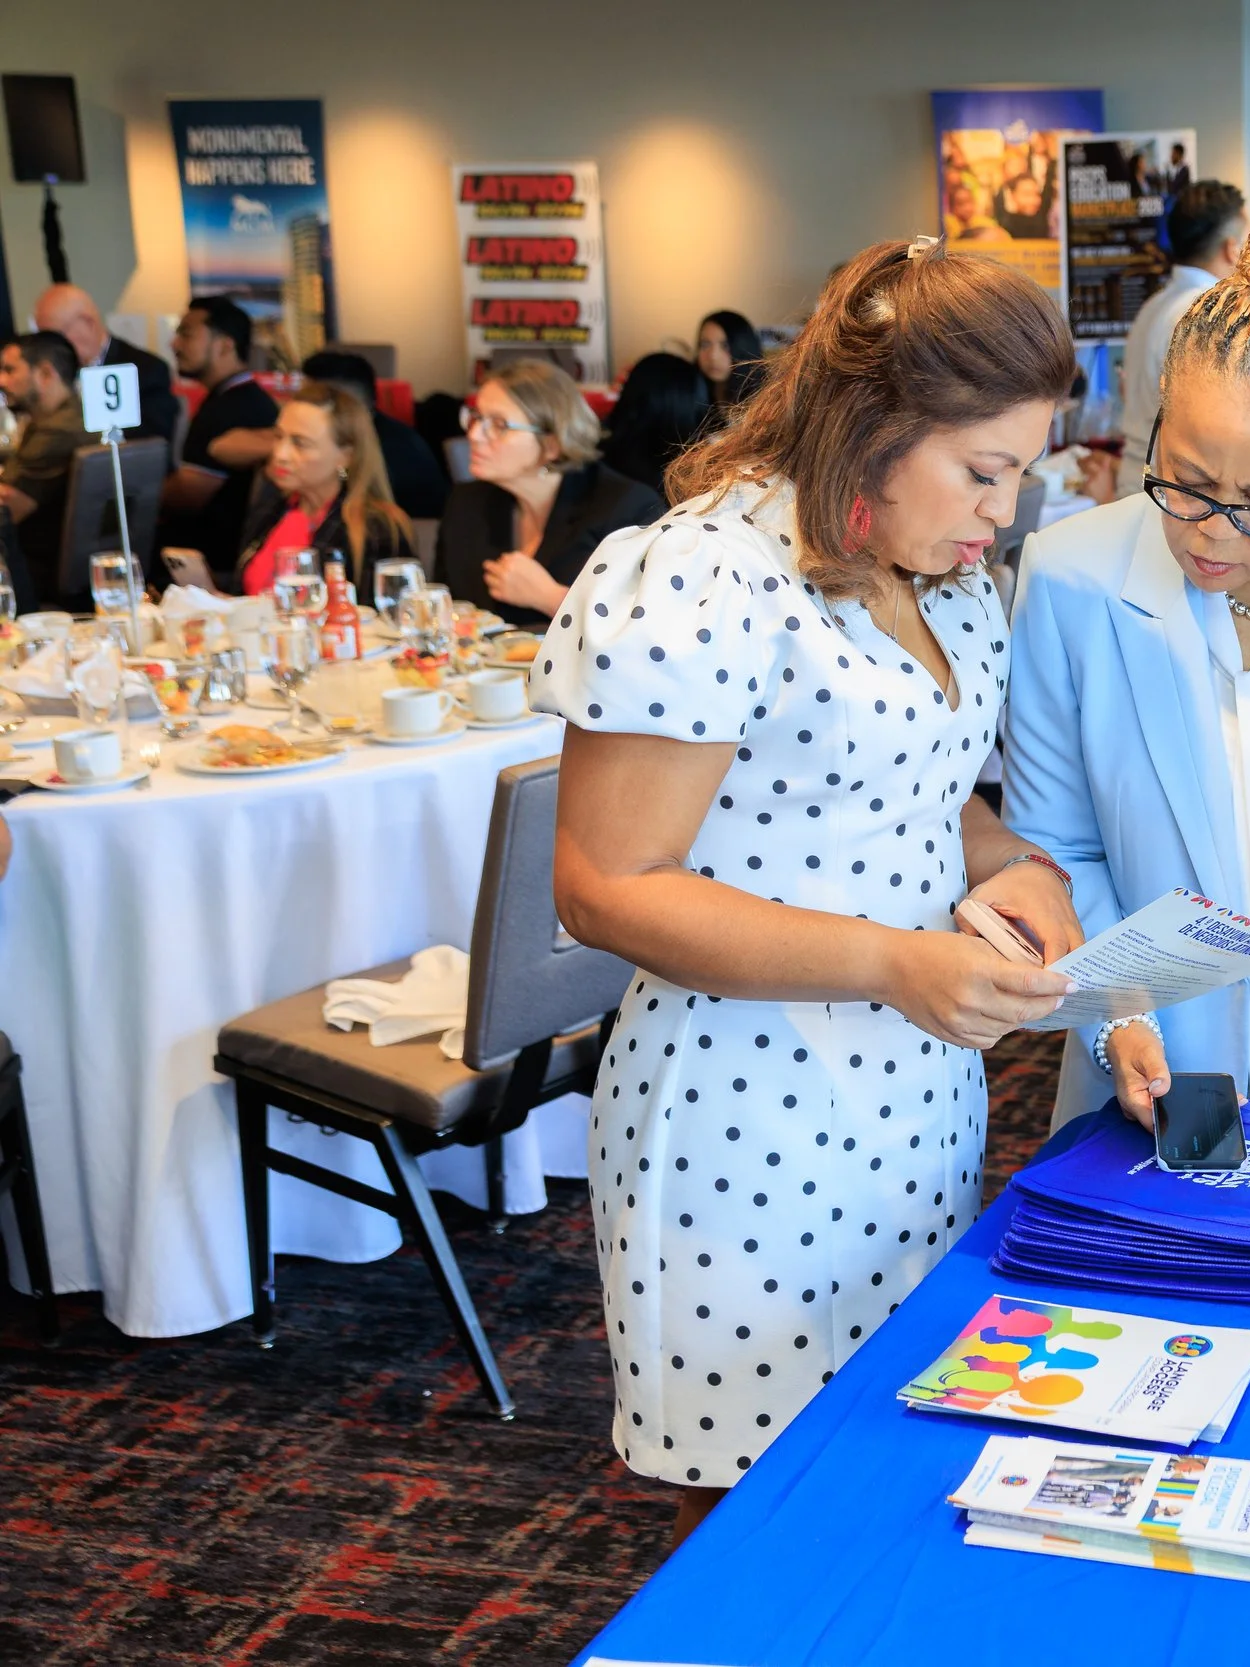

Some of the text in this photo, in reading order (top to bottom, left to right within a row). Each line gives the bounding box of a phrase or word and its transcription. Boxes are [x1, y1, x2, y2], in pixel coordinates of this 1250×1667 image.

[187, 124, 309, 154] MONUMENTAL
[185, 155, 316, 186] HAPPENS HERE
[461, 173, 575, 203] LATINO
[467, 236, 578, 265] LATINO
[471, 297, 581, 326] LATINO
[104, 374, 120, 410] 9
[1178, 923, 1198, 936] DE
[1190, 928, 1231, 950] NEGOCIOS
[1142, 1358, 1177, 1396] ACCESS
[1147, 1360, 1193, 1412] LANGUAGE
